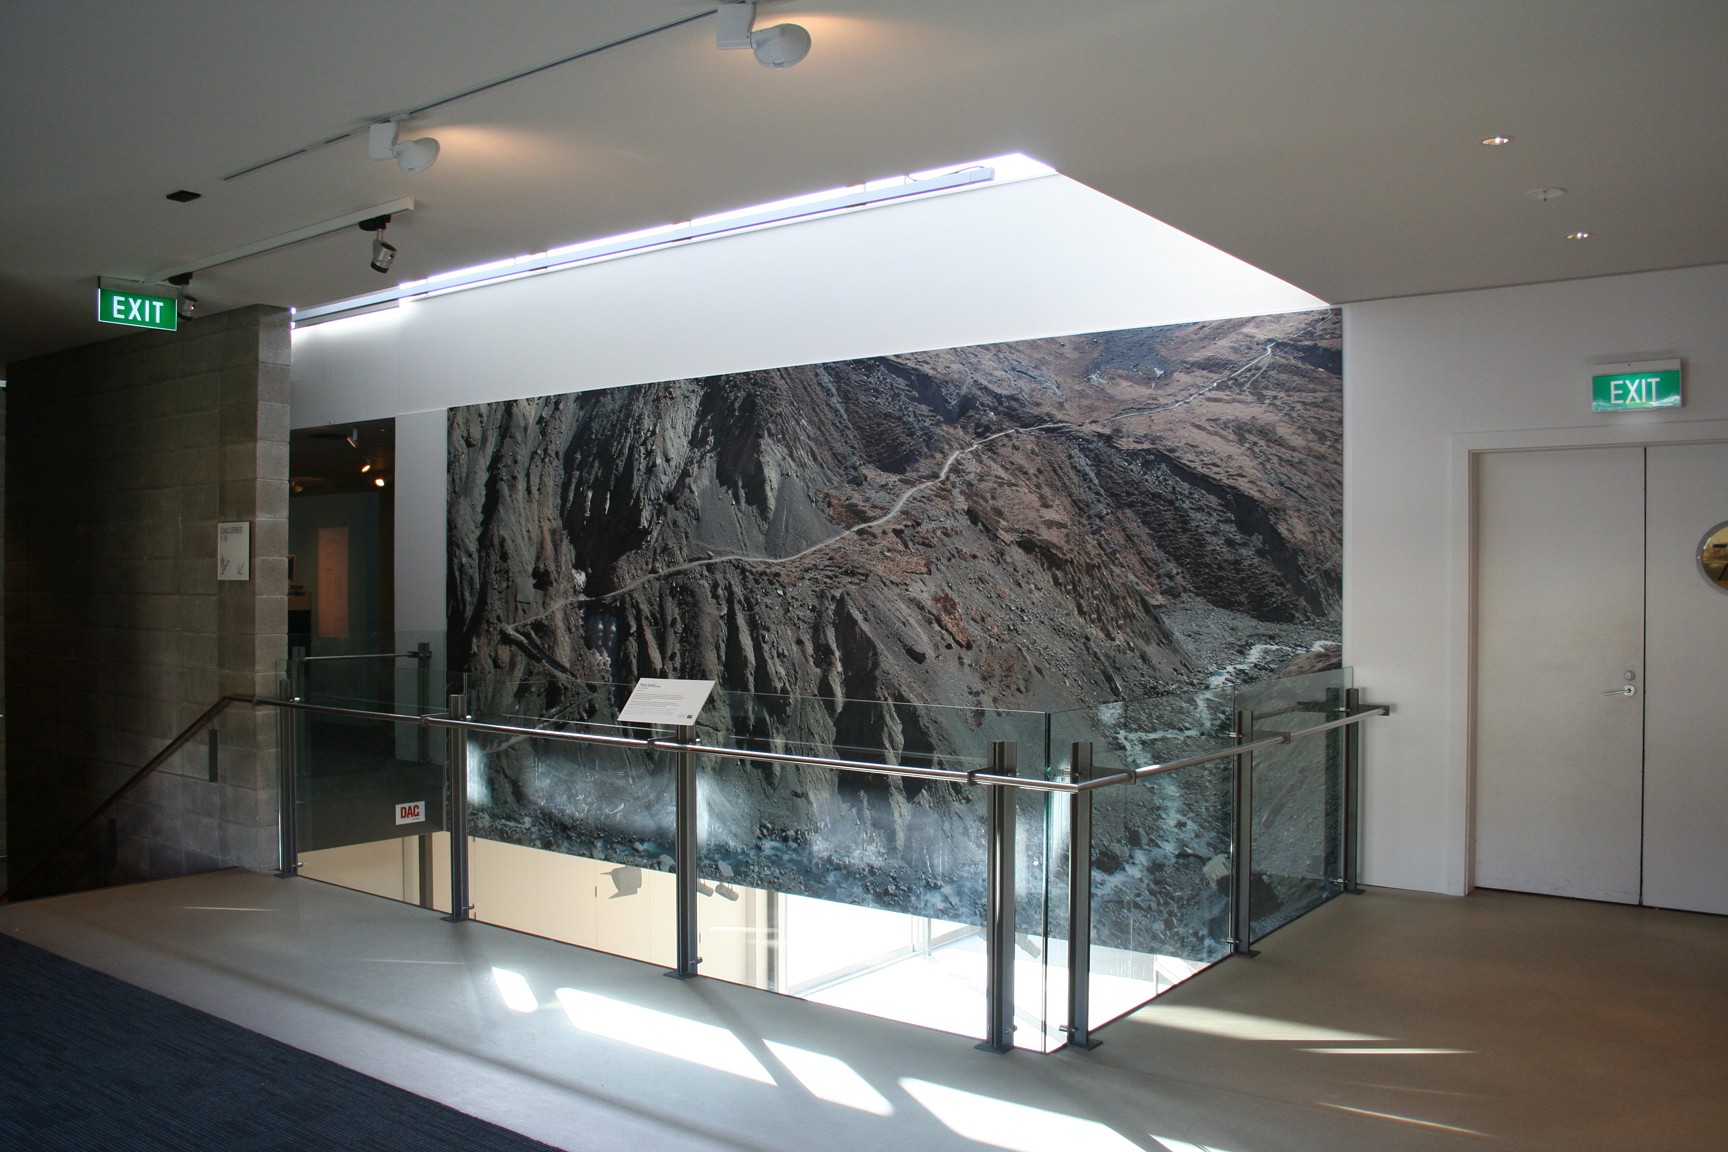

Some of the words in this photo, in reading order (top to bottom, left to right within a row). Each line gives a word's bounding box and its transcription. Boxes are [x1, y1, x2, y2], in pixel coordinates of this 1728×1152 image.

[113, 295, 163, 323] EXIT
[1610, 377, 1660, 404] EXIT
[400, 804, 420, 818] DAC
